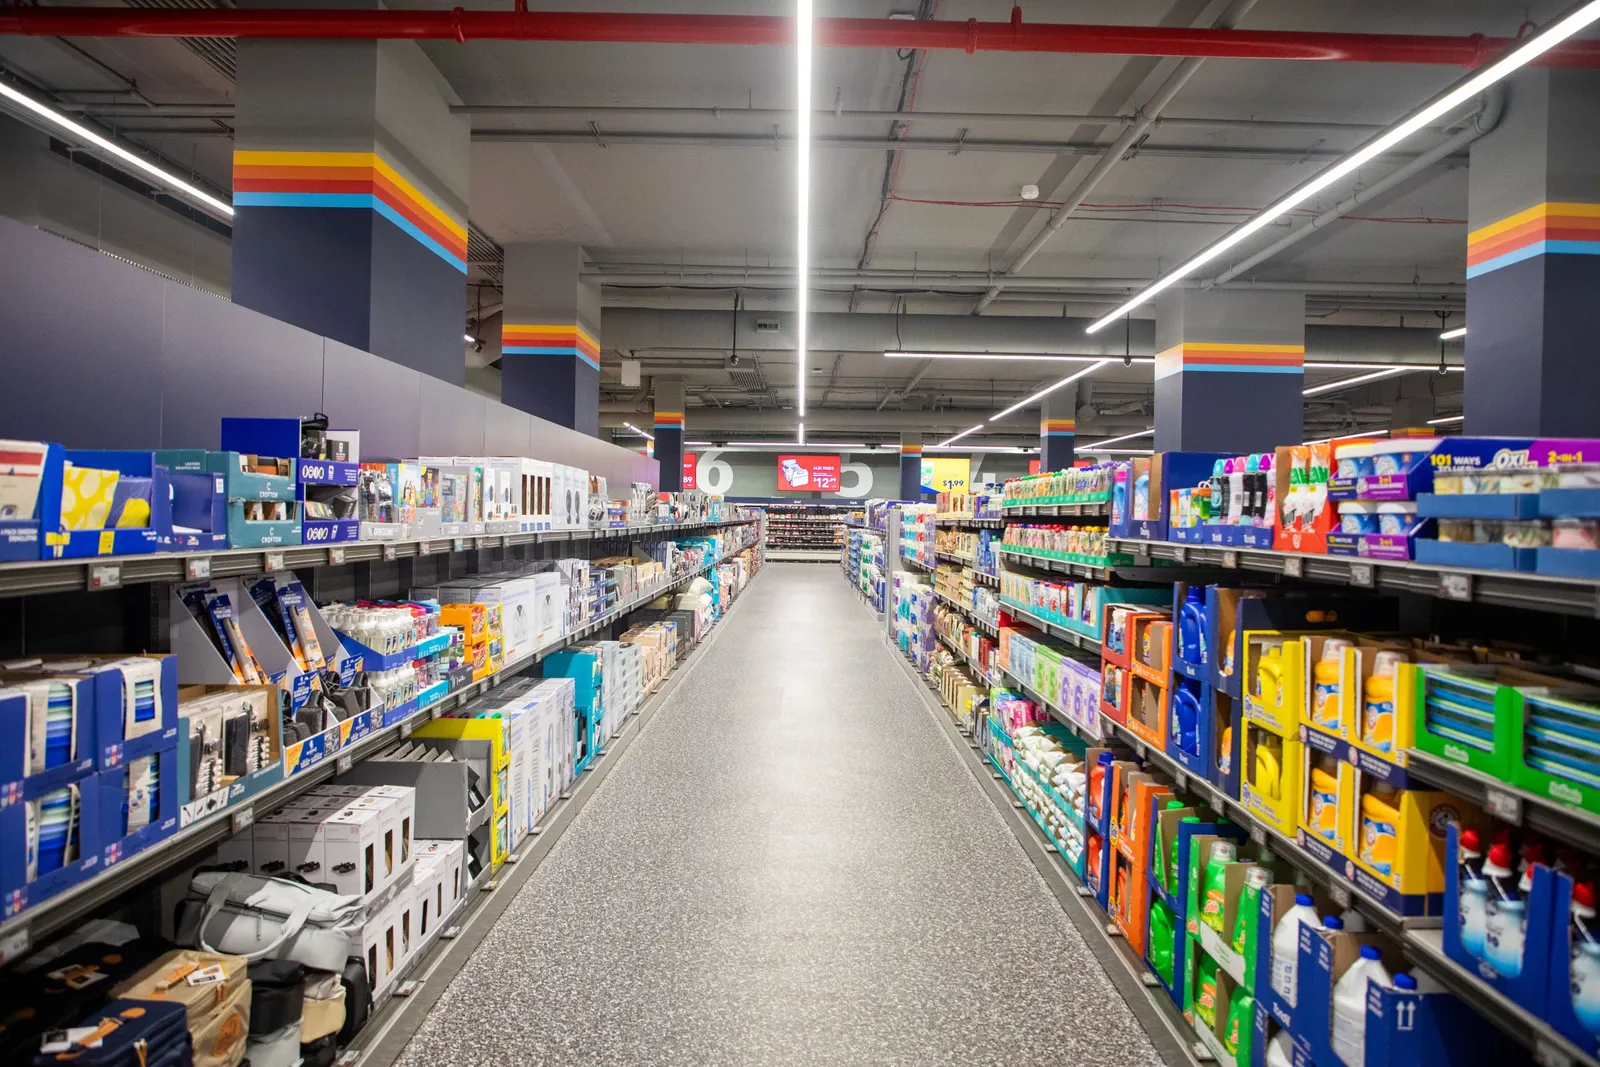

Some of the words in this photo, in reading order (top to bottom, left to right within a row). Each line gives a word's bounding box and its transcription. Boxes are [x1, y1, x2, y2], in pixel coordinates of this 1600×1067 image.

[1430, 453, 1452, 466] 101
[1453, 456, 1481, 466] WAYS
[1495, 452, 1526, 469] OXI
[696, 449, 734, 495] 6
[942, 479, 964, 490] $1.99
[259, 491, 278, 499] CROFTON
[261, 536, 282, 544] CROFTON
[1061, 676, 1069, 705] 6
[1075, 685, 1082, 714] 6
[1087, 693, 1095, 724] 6
